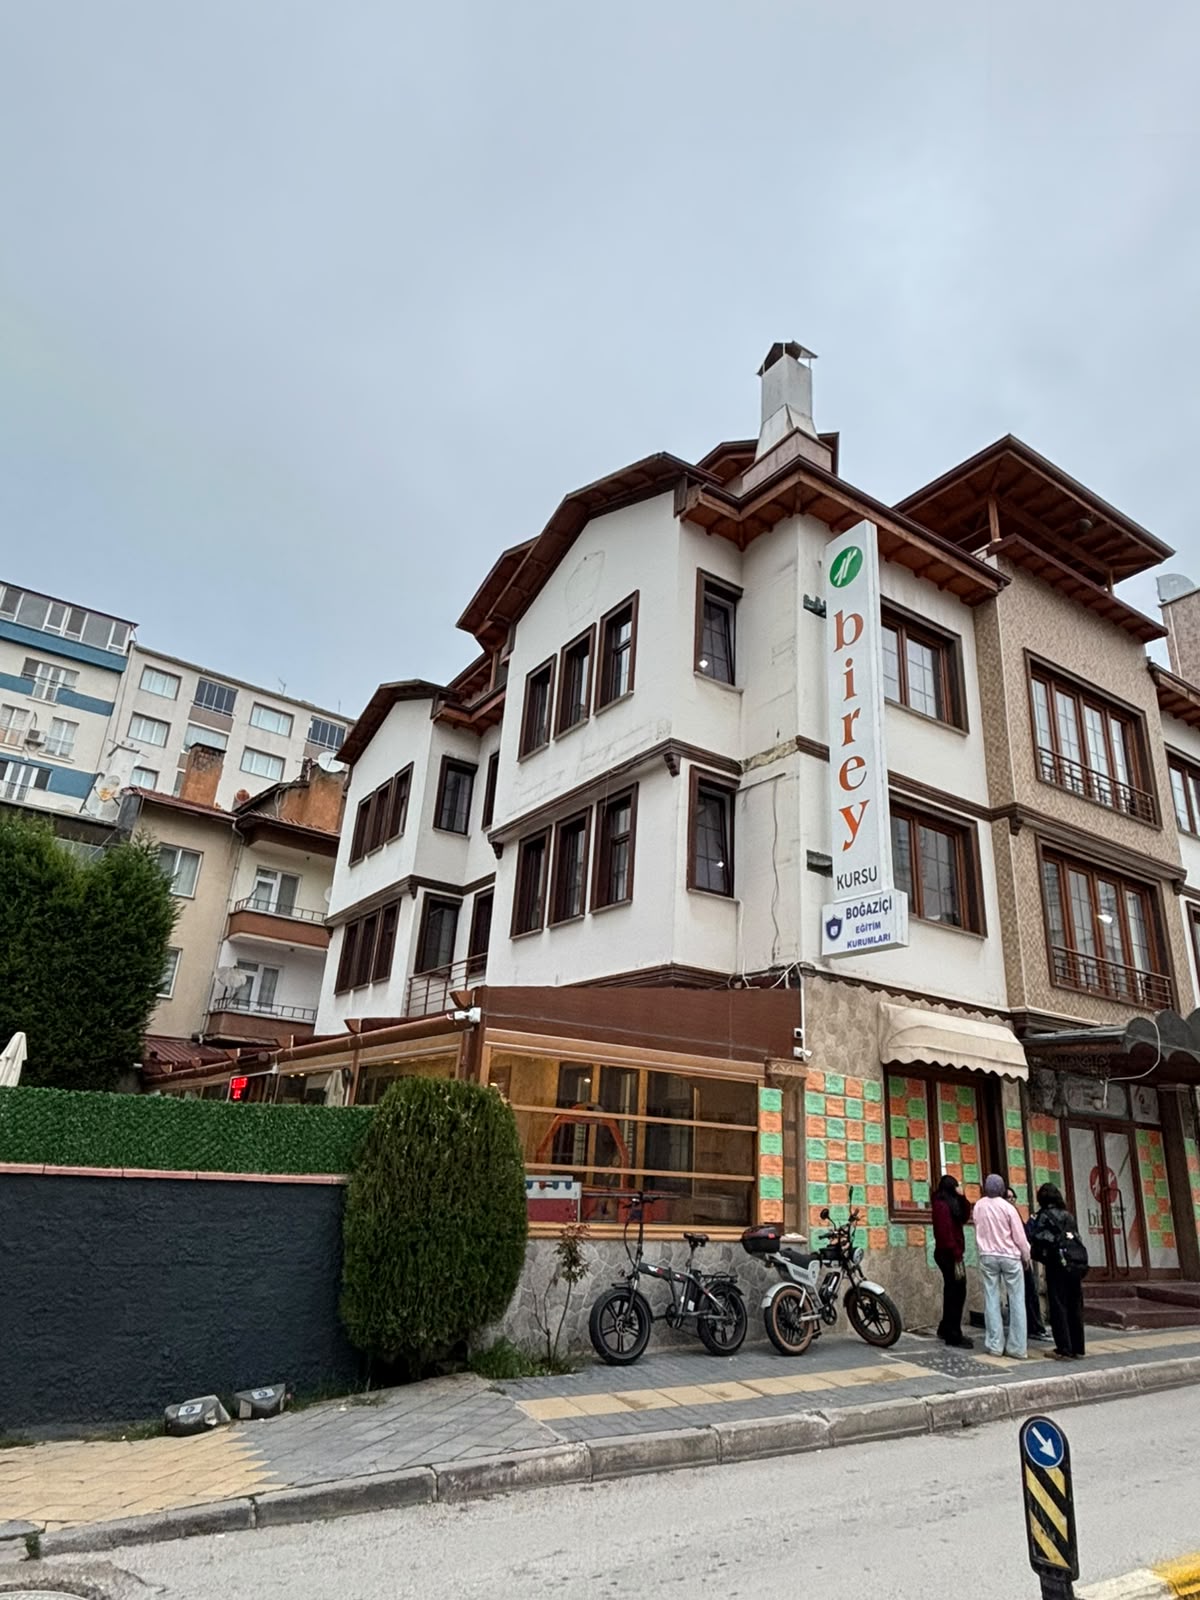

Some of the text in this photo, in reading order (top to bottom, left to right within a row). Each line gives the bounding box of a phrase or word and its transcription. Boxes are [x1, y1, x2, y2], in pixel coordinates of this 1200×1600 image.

[833, 609, 870, 852] birey
[836, 866, 877, 890] KURSU
[846, 896, 892, 919] BOĞAZİÇİ
[855, 920, 881, 934] EĞİTİM
[847, 933, 891, 948] KURUMLARI
